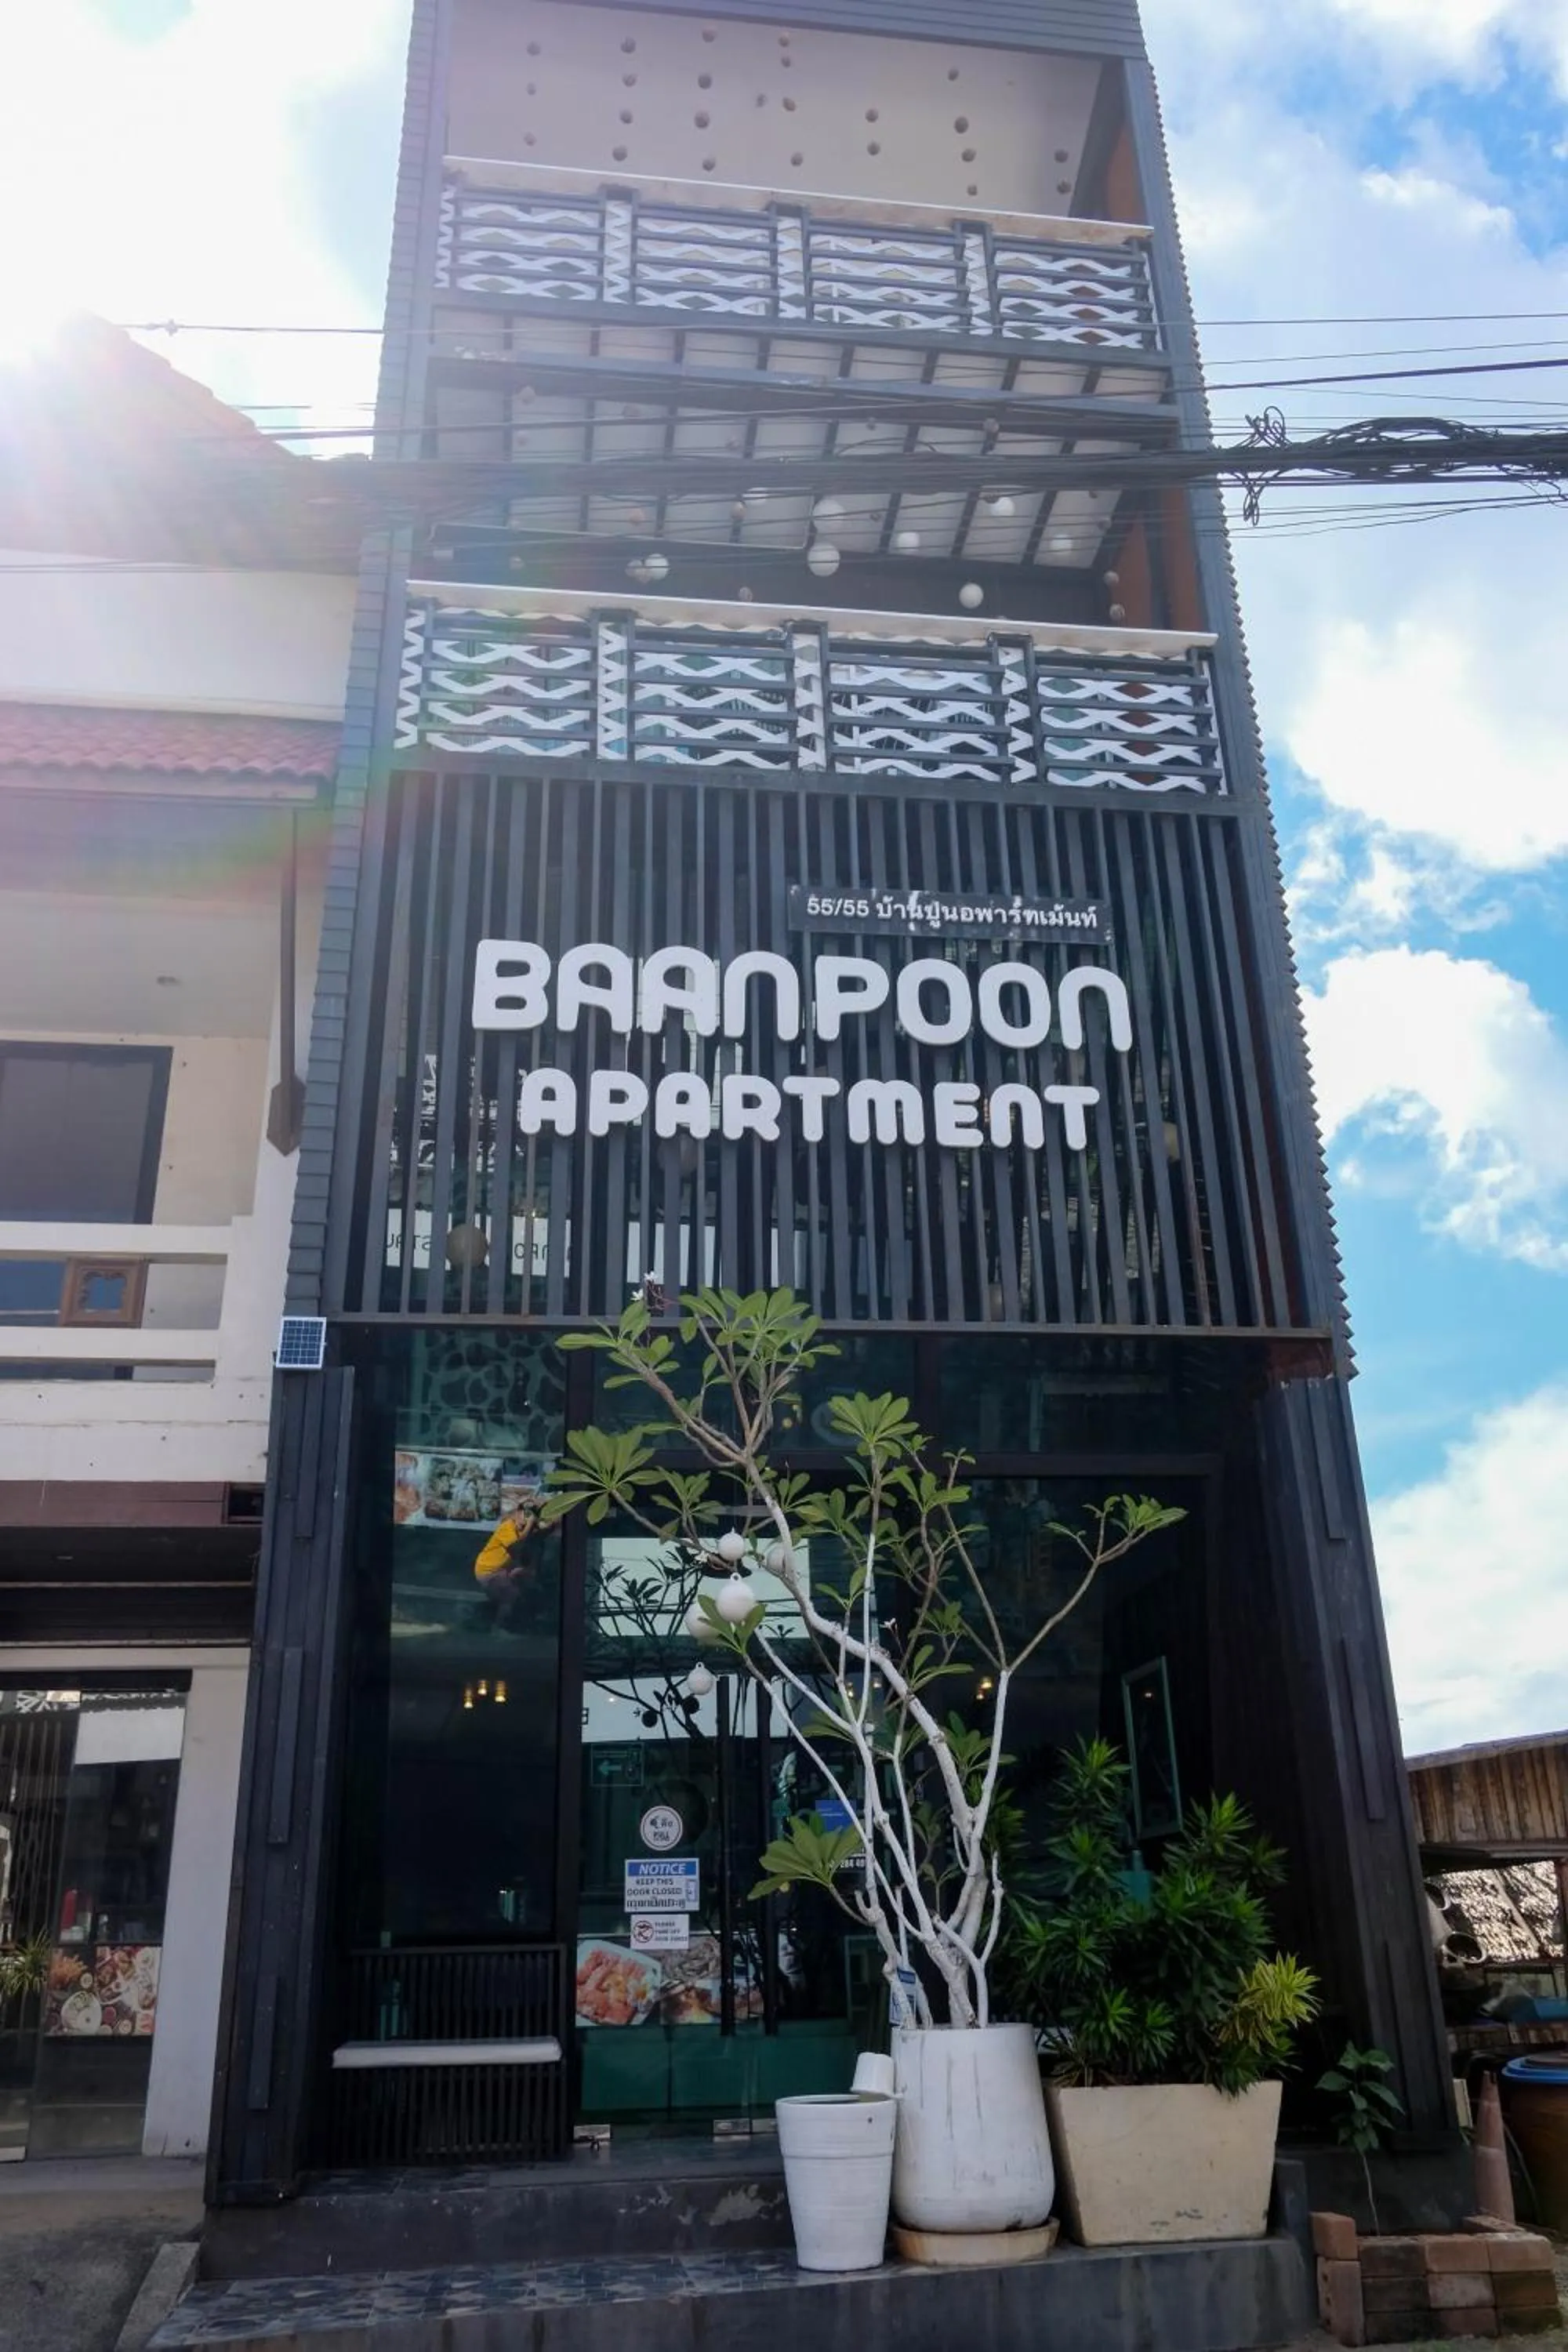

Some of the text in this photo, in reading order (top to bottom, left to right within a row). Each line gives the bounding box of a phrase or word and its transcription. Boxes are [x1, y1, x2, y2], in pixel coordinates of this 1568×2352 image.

[806, 897, 869, 916] 55/55
[520, 1067, 1100, 1151] APARTMENT
[639, 1863, 686, 1875] NOTICE
[627, 1887, 650, 1896] DOOR
